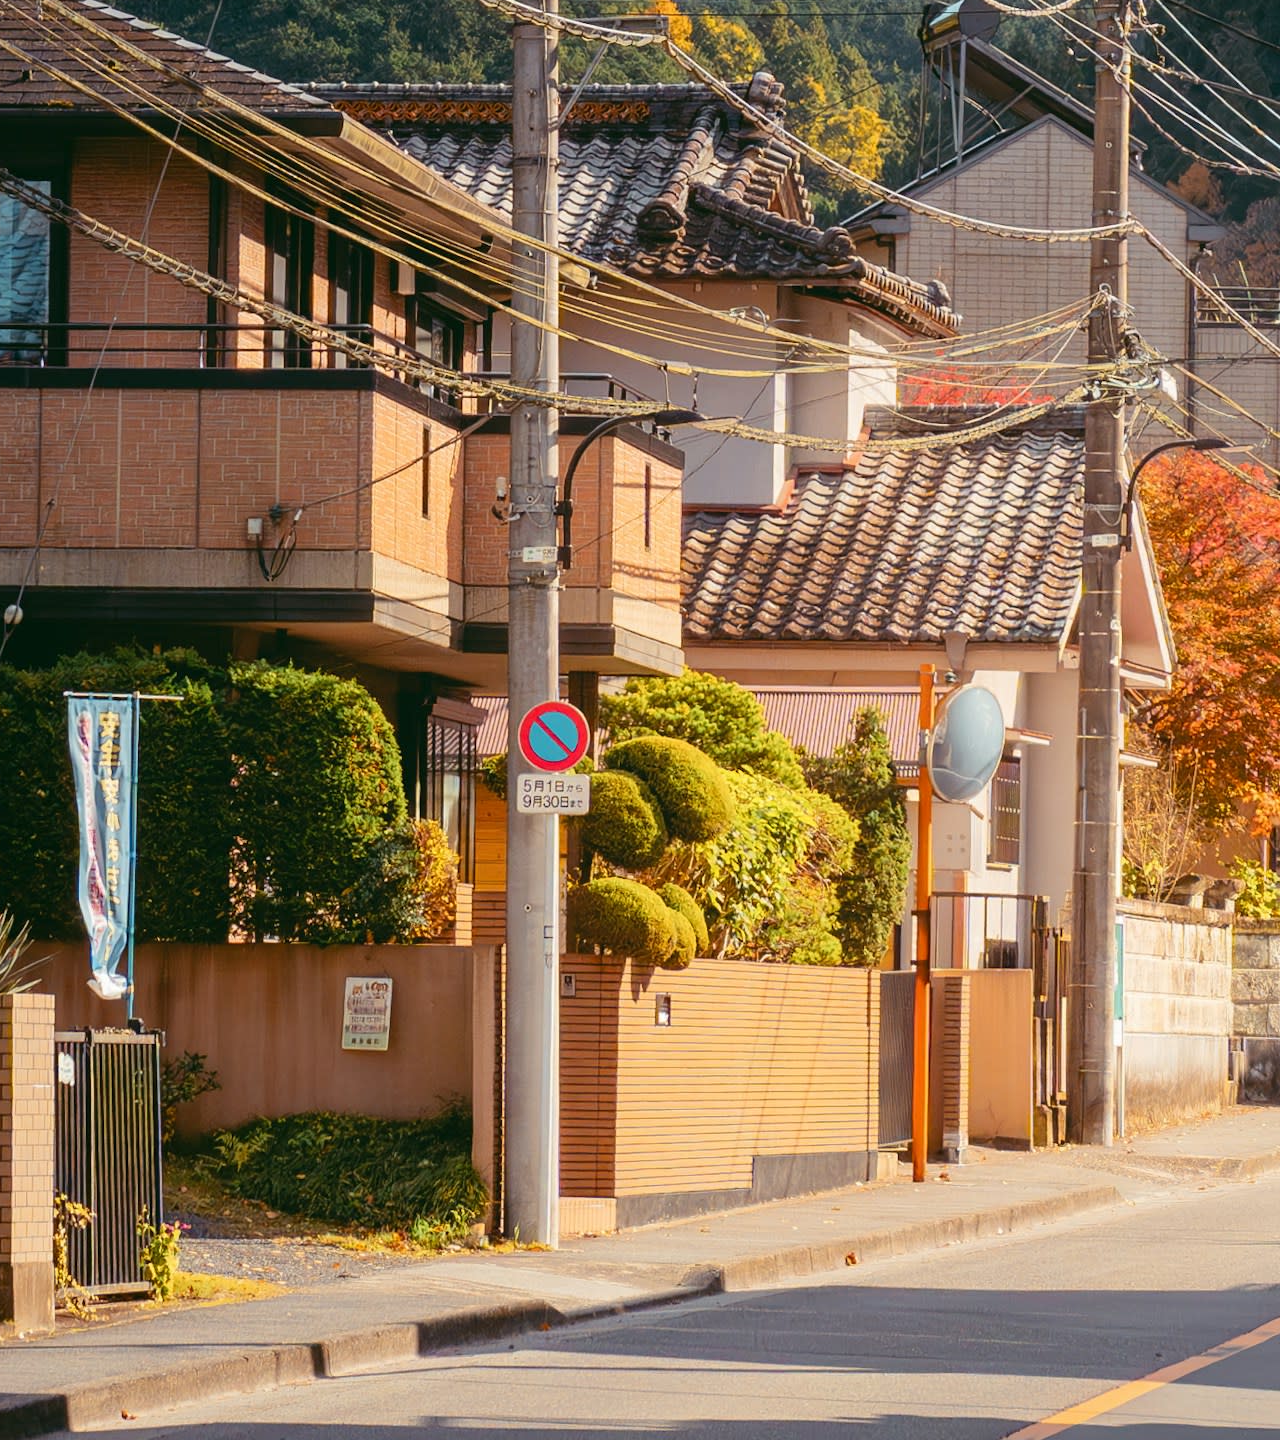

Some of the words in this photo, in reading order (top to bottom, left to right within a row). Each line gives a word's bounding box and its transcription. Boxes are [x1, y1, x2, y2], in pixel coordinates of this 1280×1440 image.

[523, 779, 583, 793] 5月1日から
[522, 795, 583, 808] 9月30日まで
